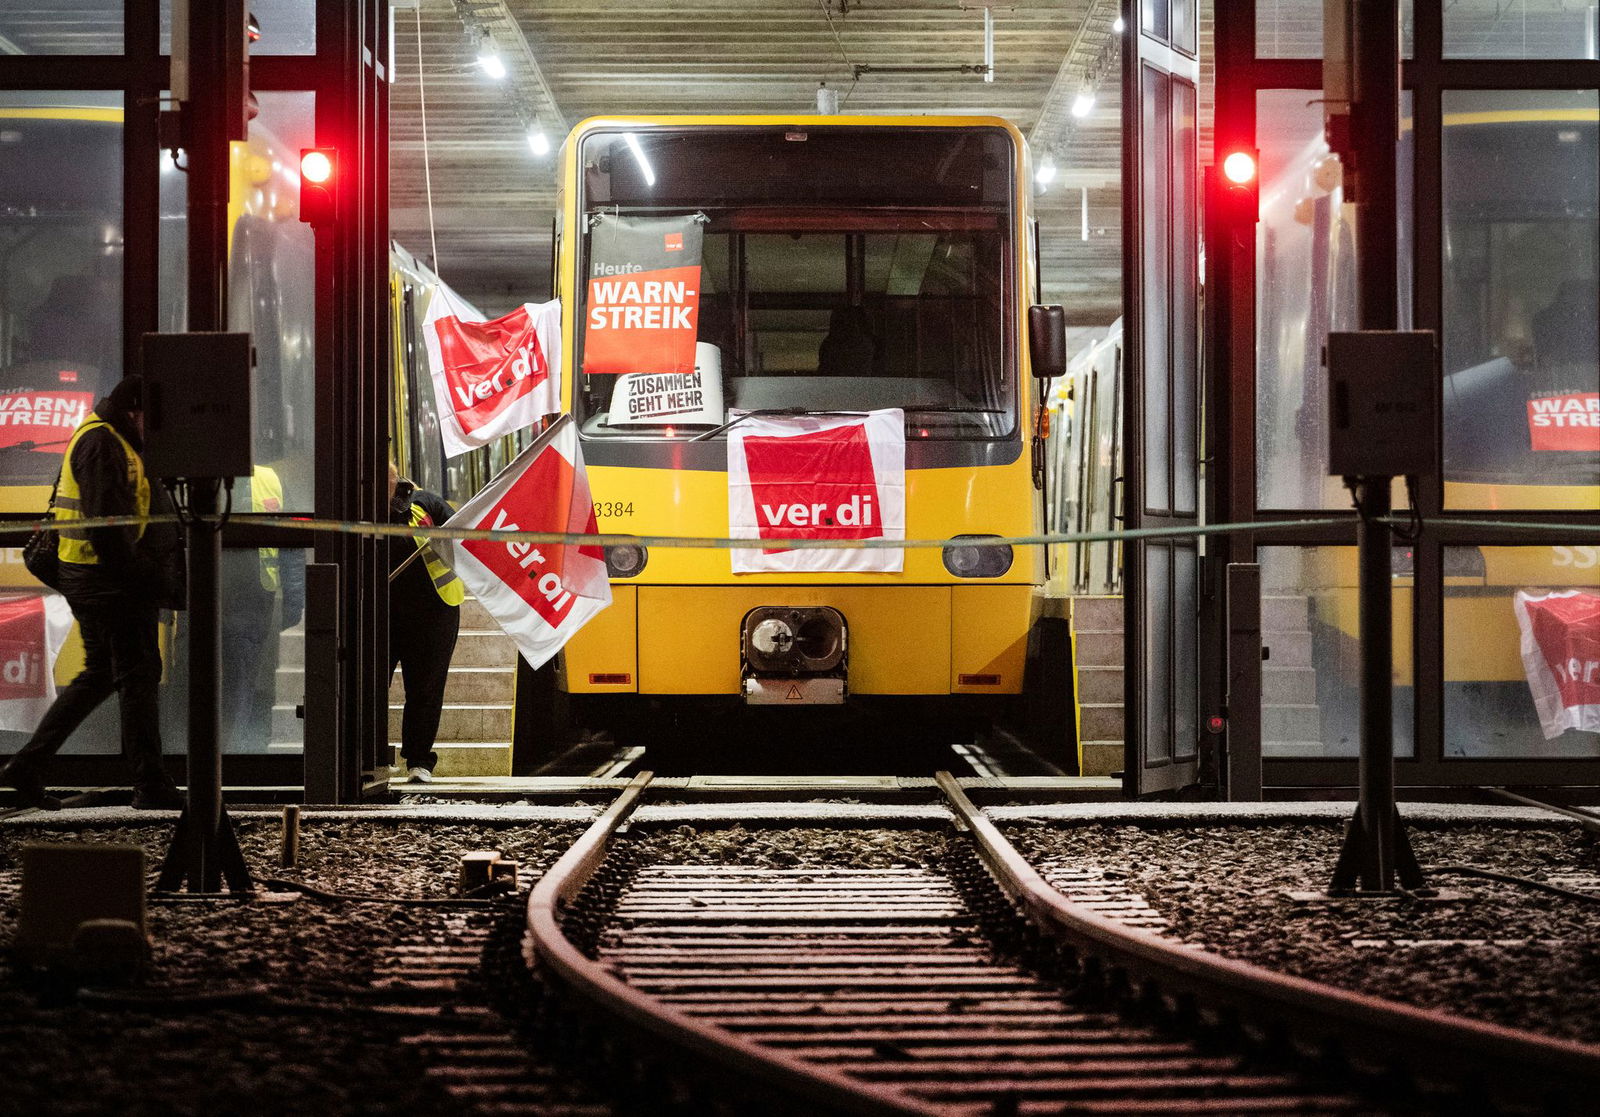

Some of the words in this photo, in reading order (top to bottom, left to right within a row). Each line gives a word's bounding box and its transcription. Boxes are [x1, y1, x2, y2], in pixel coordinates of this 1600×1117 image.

[593, 262, 643, 276] Heute
[592, 281, 697, 304] WARN-
[590, 305, 694, 330] STREIK
[628, 371, 702, 397] ZUSAMMEN
[628, 395, 662, 414] GEHT
[667, 390, 704, 409] MEHR
[594, 501, 635, 518] 3384
[761, 494, 873, 527] ver.di
